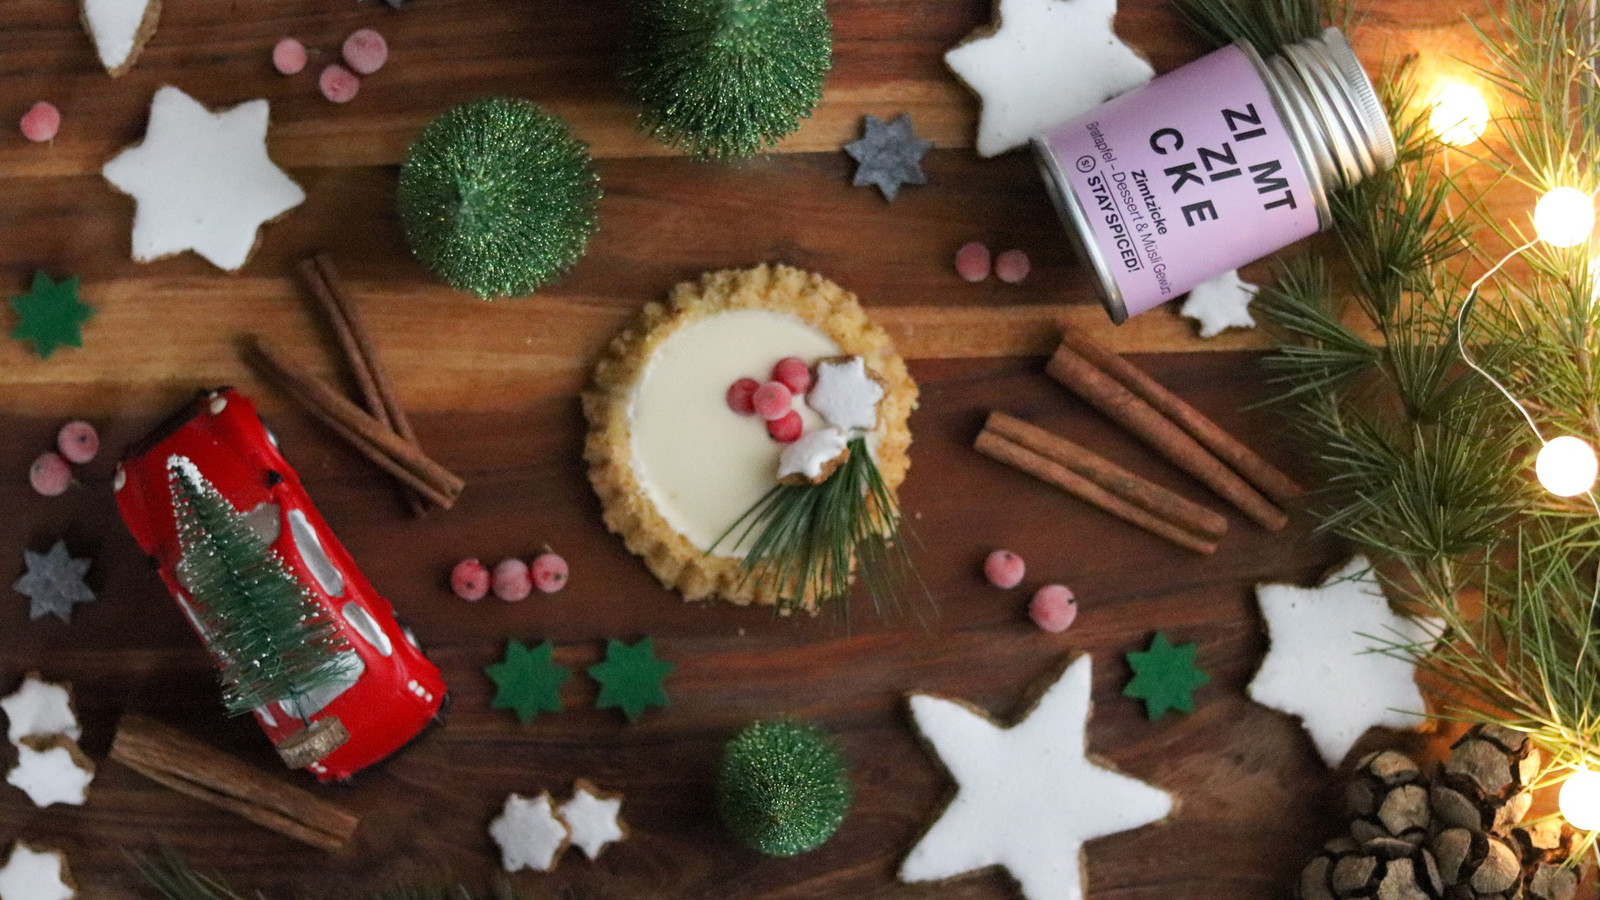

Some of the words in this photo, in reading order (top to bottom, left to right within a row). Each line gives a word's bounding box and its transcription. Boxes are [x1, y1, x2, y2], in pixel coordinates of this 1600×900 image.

[1086, 121, 1117, 165] Bratapfel
[1197, 142, 1242, 182] ZI
[1221, 104, 1266, 142] ZI
[1248, 160, 1297, 210] MT
[1111, 171, 1144, 222] Dessert
[1131, 169, 1167, 235] Zimtzicke
[1087, 176, 1114, 217] STAY
[1105, 213, 1140, 273] SPICED!
[1135, 223, 1148, 232] &
[1140, 232, 1160, 265] Müsli
